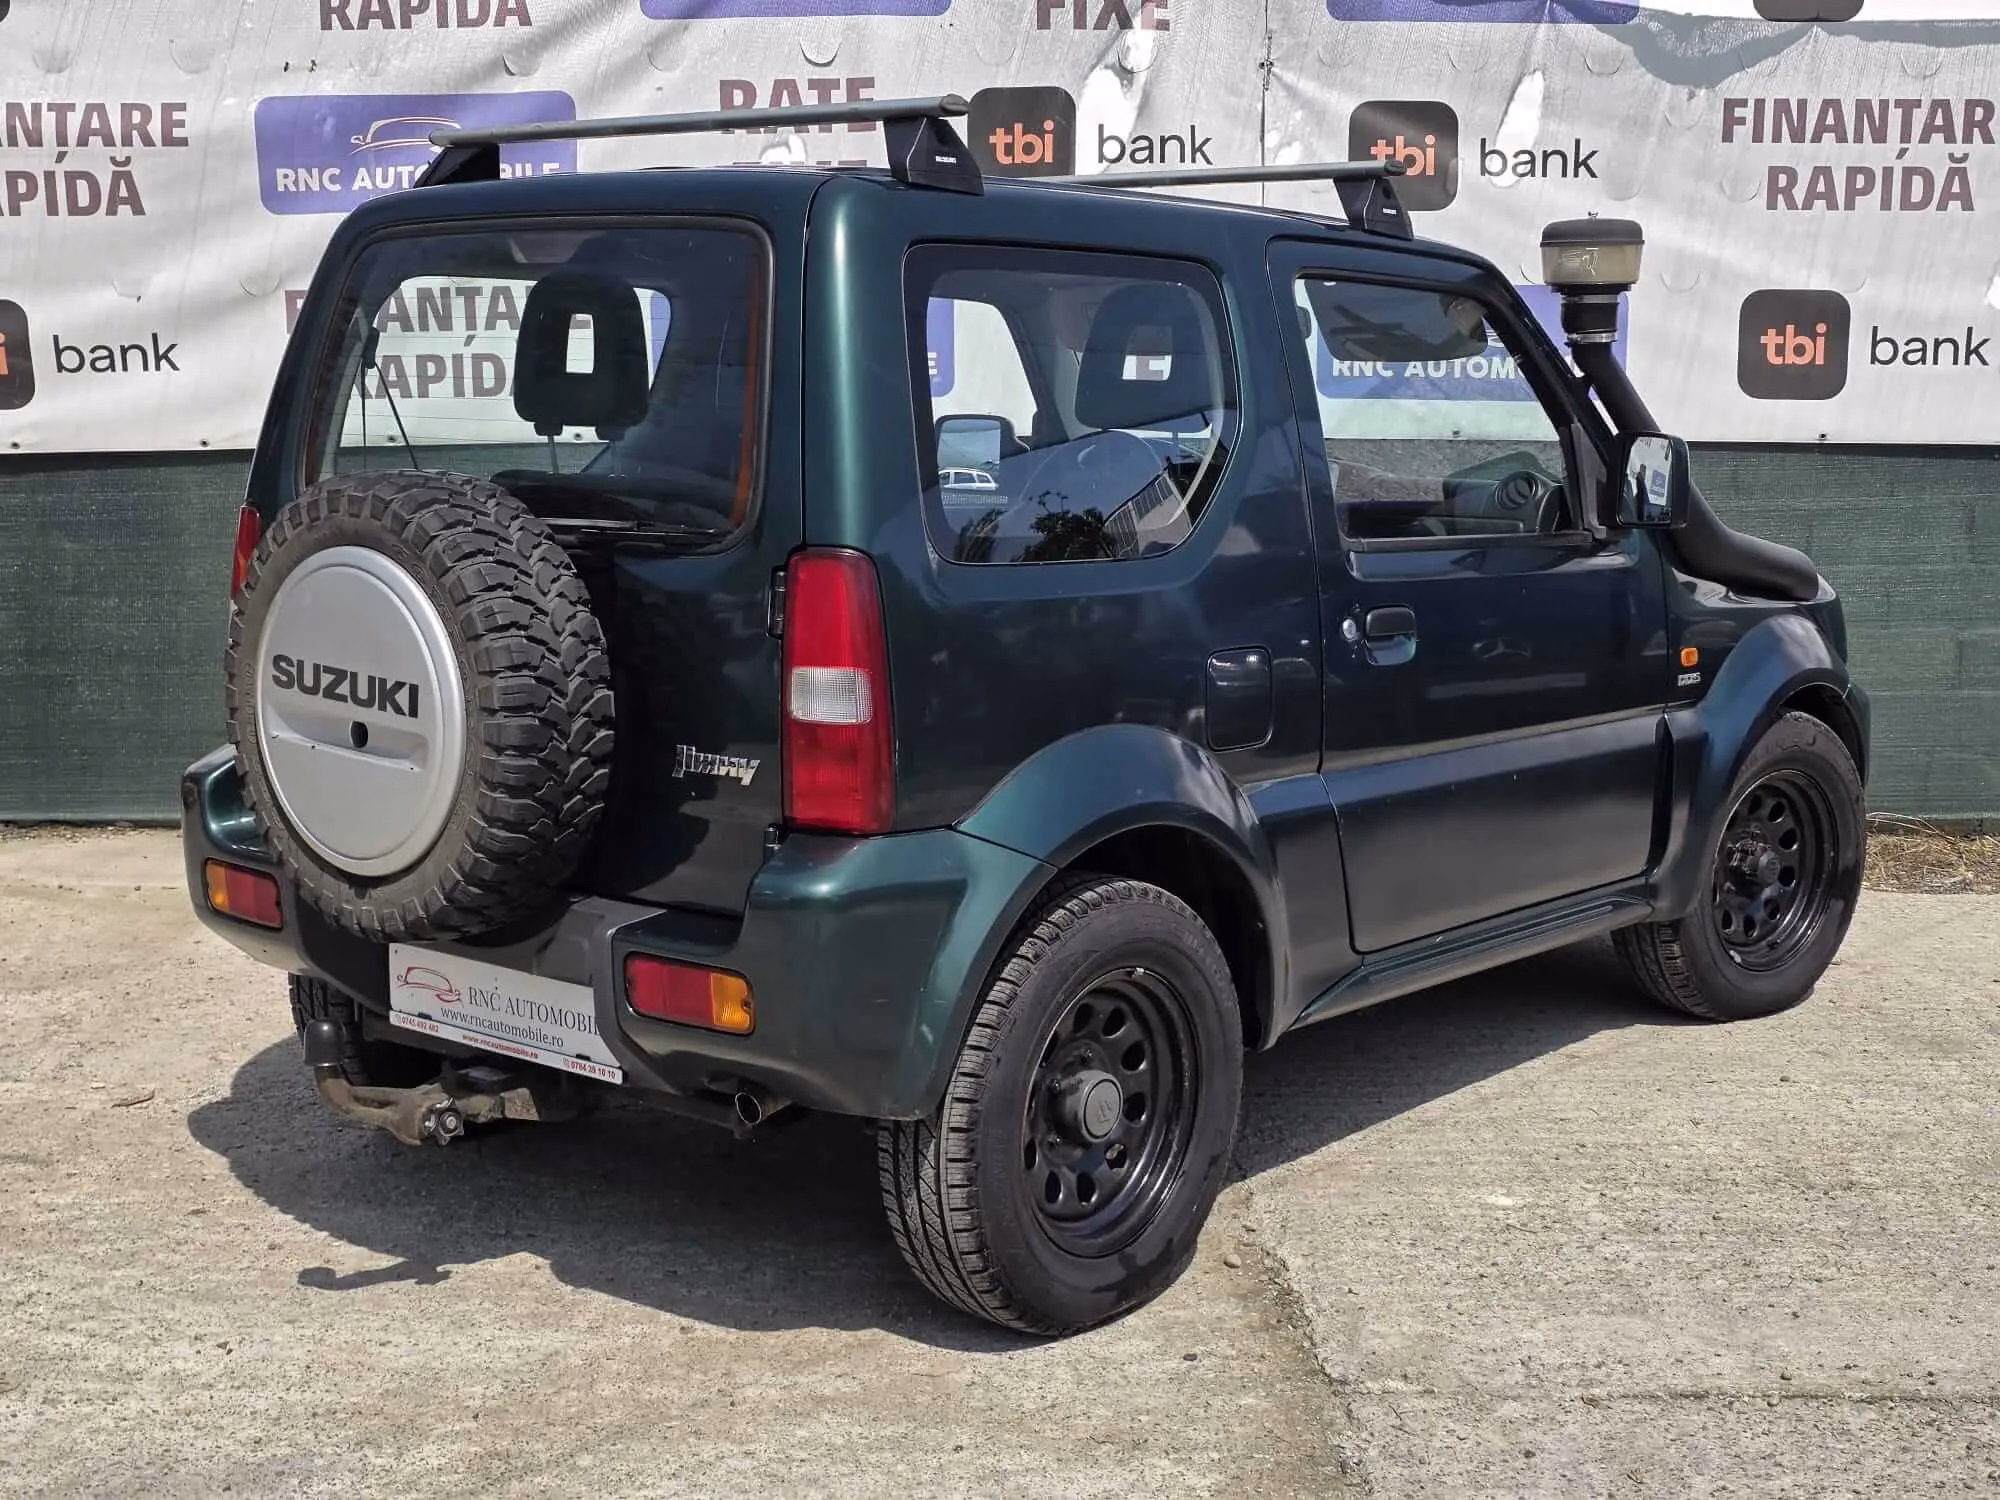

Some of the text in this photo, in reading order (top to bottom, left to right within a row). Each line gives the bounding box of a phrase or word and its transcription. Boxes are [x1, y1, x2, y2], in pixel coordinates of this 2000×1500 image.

[1036, 0, 1171, 32] FIXE
[719, 76, 877, 134] RATE
[0, 102, 189, 164] NȚARE
[989, 119, 1214, 165] tbi bank
[1370, 134, 1600, 178] tbi bank
[0, 155, 146, 216] PIDĂ
[276, 167, 342, 192] RNC
[1766, 152, 1975, 211] RAPIDĂ
[52, 332, 180, 374] bank
[1760, 322, 1991, 366] tbi bank
[1332, 356, 1526, 379] RNC AUTOM
[271, 654, 420, 719] SUZUKI
[468, 986, 500, 1012] RNC
[440, 1006, 564, 1048] www.rncautomobile.ro
[607, 1070, 616, 1080] 10
